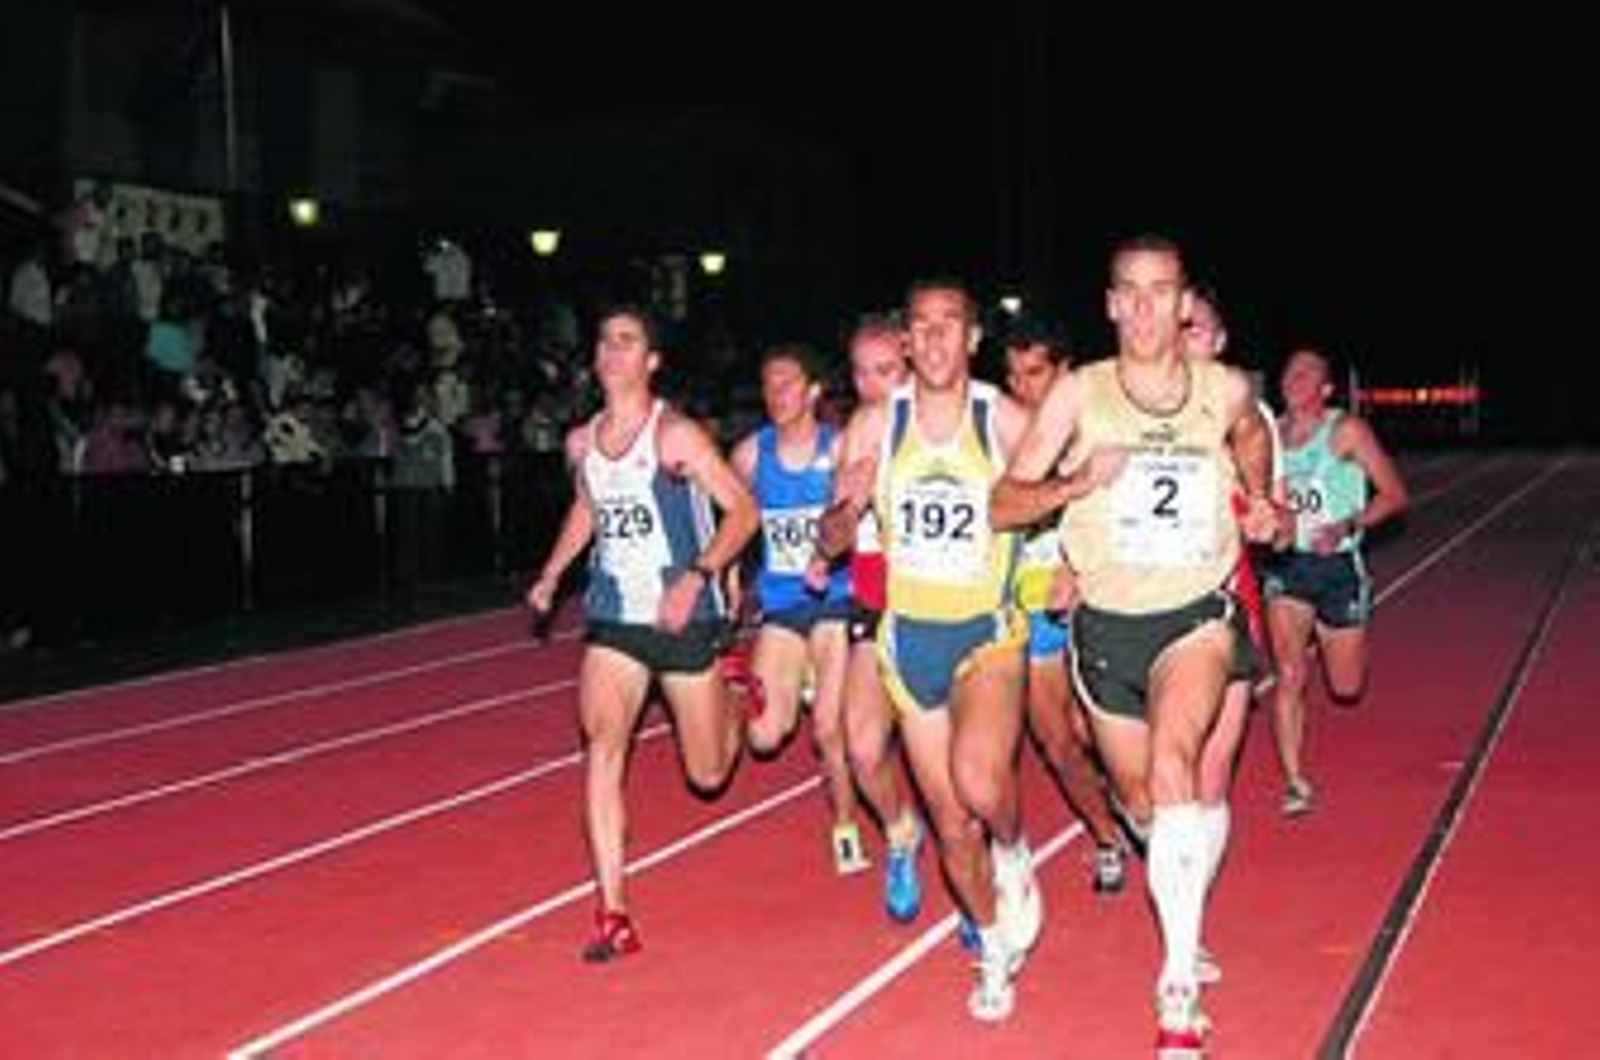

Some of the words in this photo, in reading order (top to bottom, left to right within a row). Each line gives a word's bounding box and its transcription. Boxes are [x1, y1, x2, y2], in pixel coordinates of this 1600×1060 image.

[1152, 476, 1179, 518] 2
[597, 503, 653, 538] 229
[900, 500, 974, 539] 192
